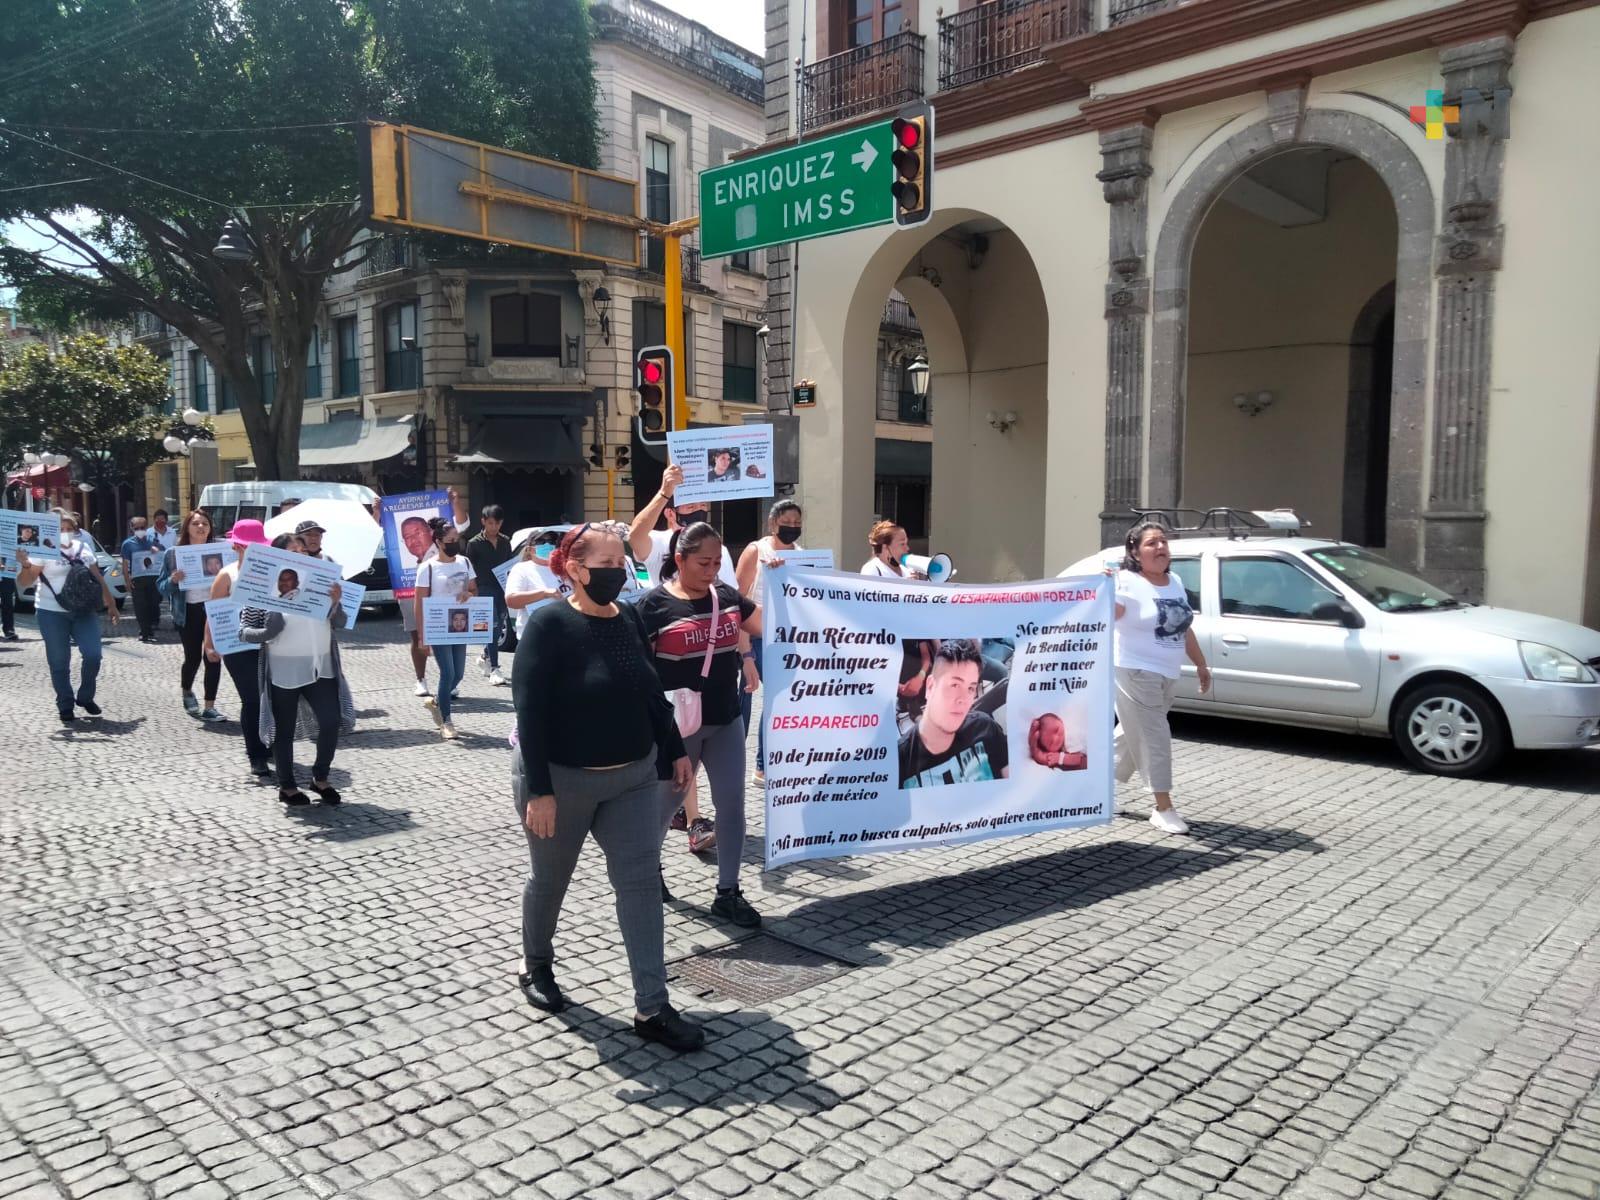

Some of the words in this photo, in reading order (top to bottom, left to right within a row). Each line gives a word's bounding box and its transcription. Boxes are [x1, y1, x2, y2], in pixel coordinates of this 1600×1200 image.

[714, 151, 835, 206] ENRIQUEZ
[783, 189, 855, 228] IMSS
[782, 583, 798, 598] Yo
[802, 585, 825, 601] soy
[828, 589, 851, 600] una
[854, 588, 900, 603] víctima
[932, 592, 948, 604] de
[684, 621, 739, 646] HILFGER
[774, 626, 819, 645] Alan
[822, 627, 896, 650] Ricardo
[1016, 621, 1039, 638] Me
[1041, 621, 1107, 635] arrebataste
[1025, 642, 1037, 655] la
[1039, 638, 1098, 654] Bendición
[782, 652, 889, 674] Domínguez
[1024, 660, 1037, 673] de
[1039, 661, 1059, 672] ver
[1061, 660, 1096, 671] nacer
[789, 678, 875, 701] Gutiérrez
[1028, 682, 1037, 692] a
[1039, 677, 1056, 692] mi
[1059, 677, 1088, 694] Niño
[772, 714, 880, 730] DESAPARECIDO
[768, 750, 783, 765] 20
[785, 748, 805, 763] de
[805, 747, 851, 767] junio
[853, 746, 888, 761] 2019
[818, 773, 834, 785] de
[836, 771, 889, 784] morelos
[772, 792, 810, 807] Estado
[812, 791, 830, 802] de
[831, 789, 879, 802] méxico
[793, 830, 836, 848] mami,
[838, 832, 858, 843] no
[860, 829, 900, 842] busca
[902, 821, 963, 840] culpables,
[965, 817, 989, 830] solo
[990, 812, 1025, 830] quiere
[1026, 803, 1103, 821] encontrarme!
